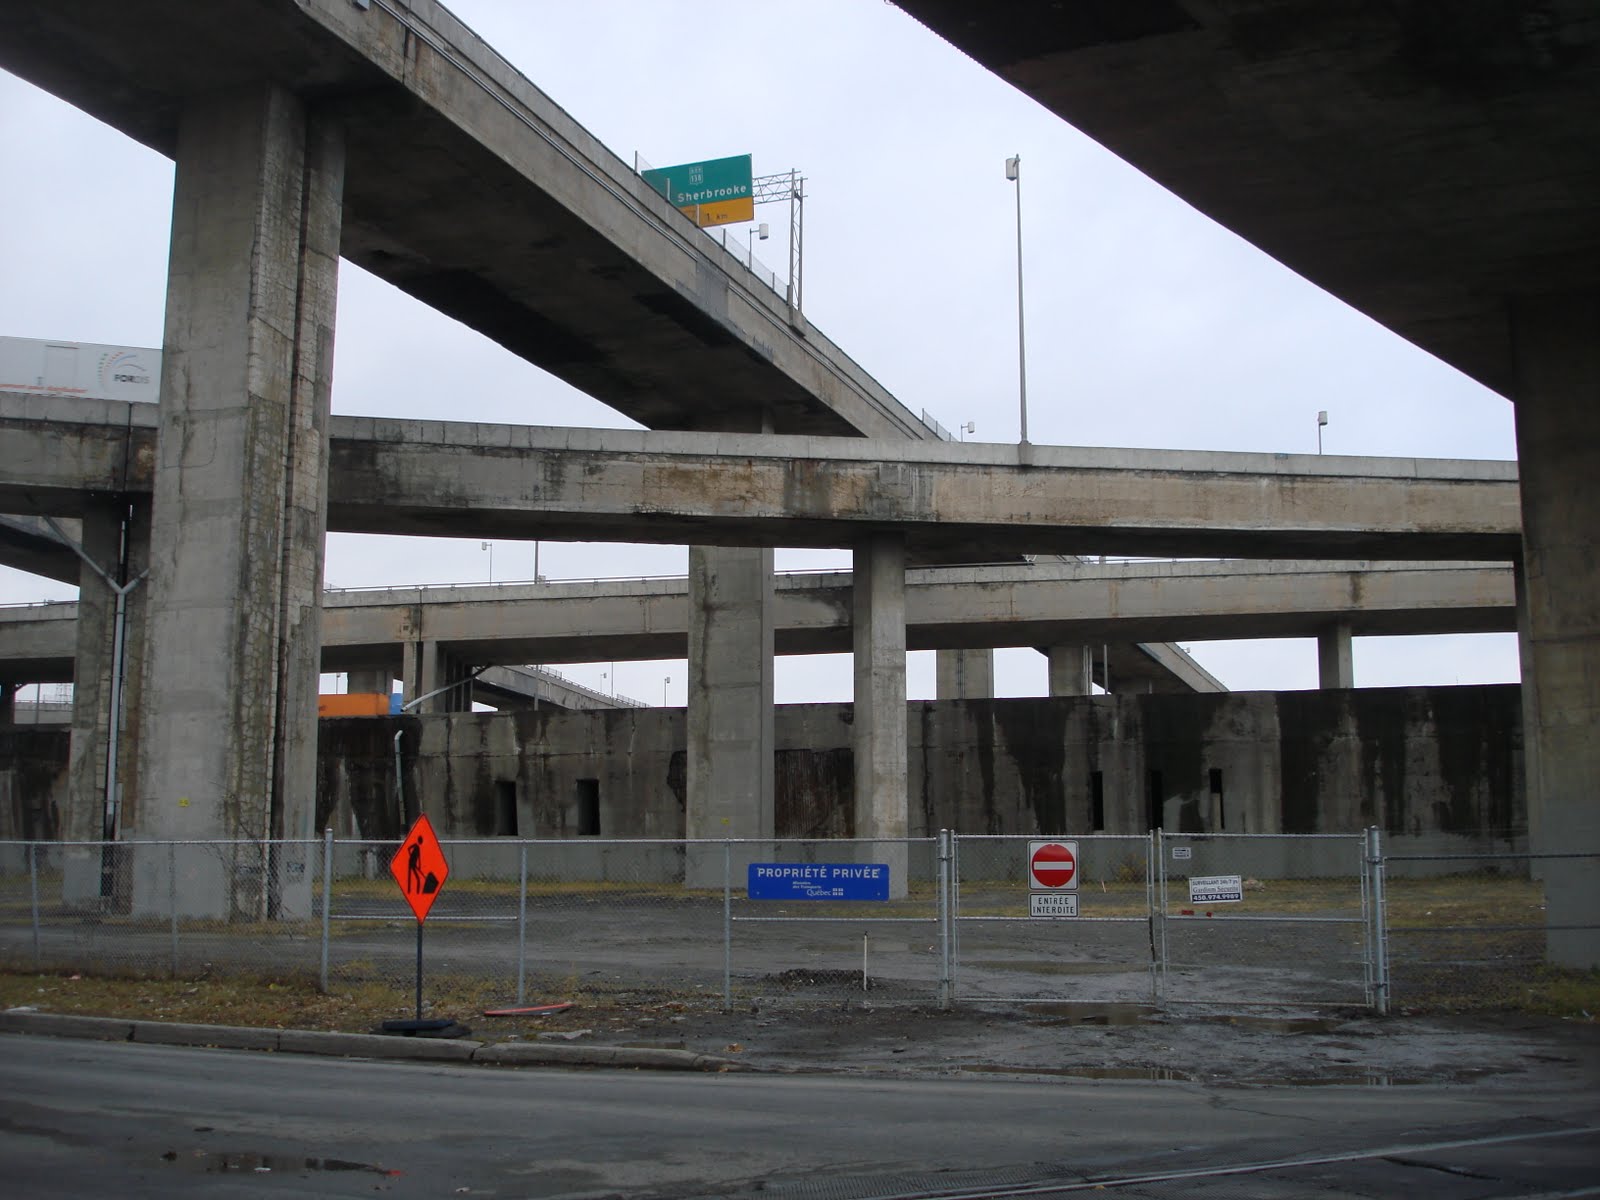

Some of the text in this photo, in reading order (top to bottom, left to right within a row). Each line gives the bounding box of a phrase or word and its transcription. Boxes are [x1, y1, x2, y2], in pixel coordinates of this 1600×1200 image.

[677, 185, 747, 203] Sherbrooke
[758, 866, 879, 878] PROPRIÉTÉ PRIVÉE
[807, 888, 831, 897] Québec
[1038, 896, 1069, 905] ENTRÉE
[1033, 906, 1074, 914] INTERDITE
